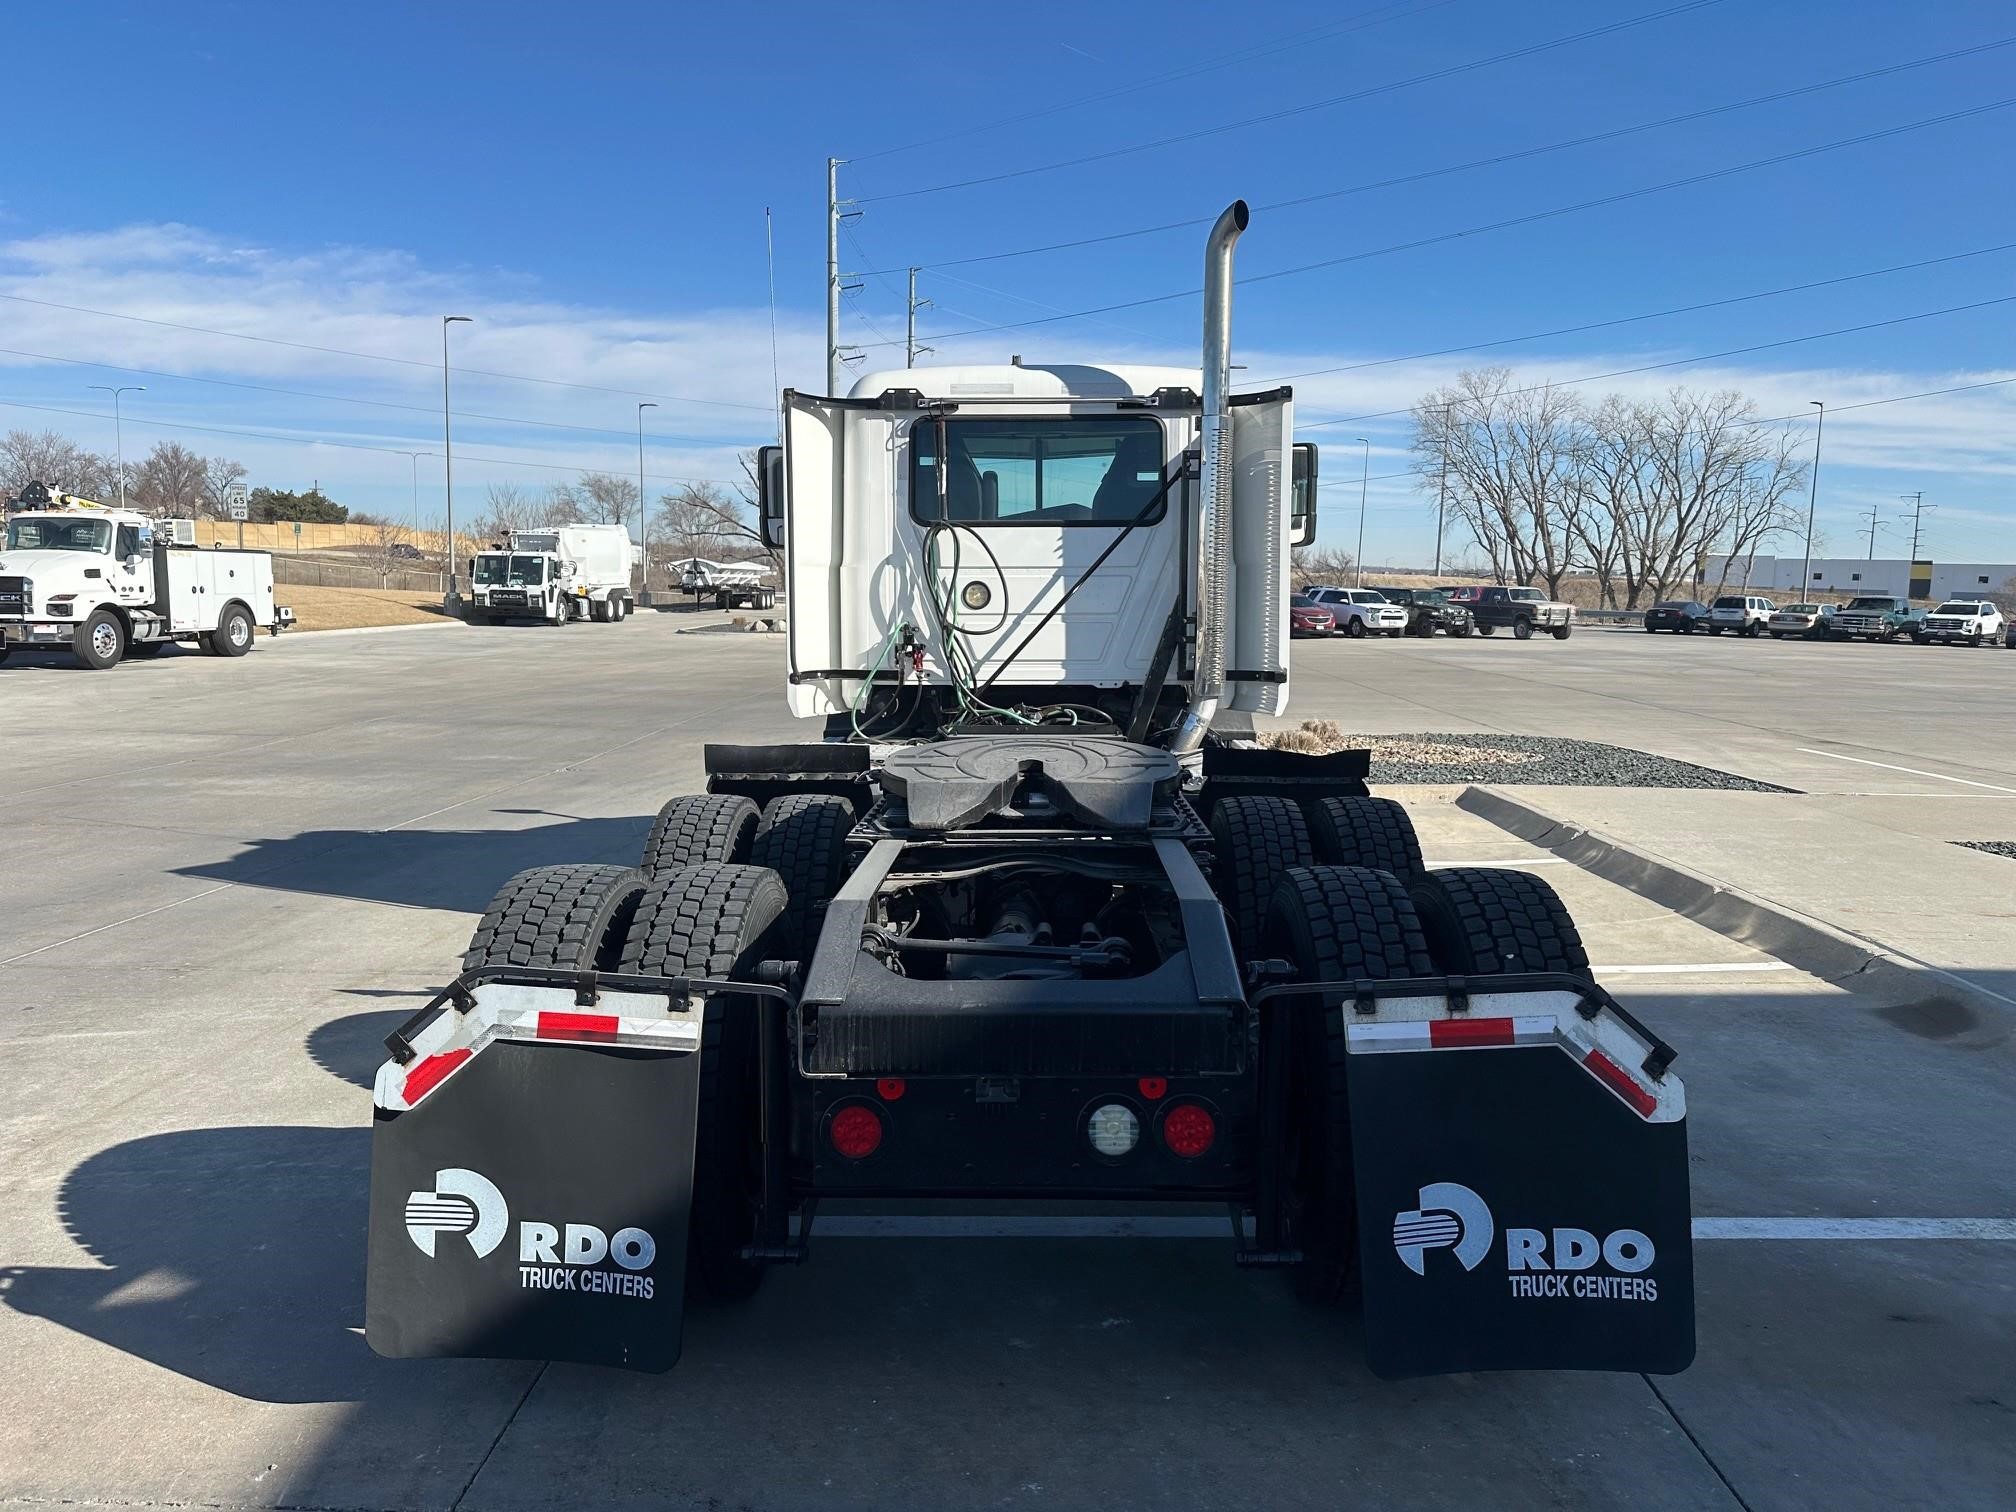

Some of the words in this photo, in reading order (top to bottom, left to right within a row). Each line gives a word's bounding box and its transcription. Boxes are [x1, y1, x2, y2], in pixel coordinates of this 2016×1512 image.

[519, 1221, 655, 1270] RDO
[1506, 1228, 1655, 1272] RDO
[519, 1266, 576, 1291] TRUCK
[580, 1270, 654, 1300] CENTERS
[1509, 1275, 1569, 1297] TRUCK
[1574, 1276, 1657, 1301] CENTERS
